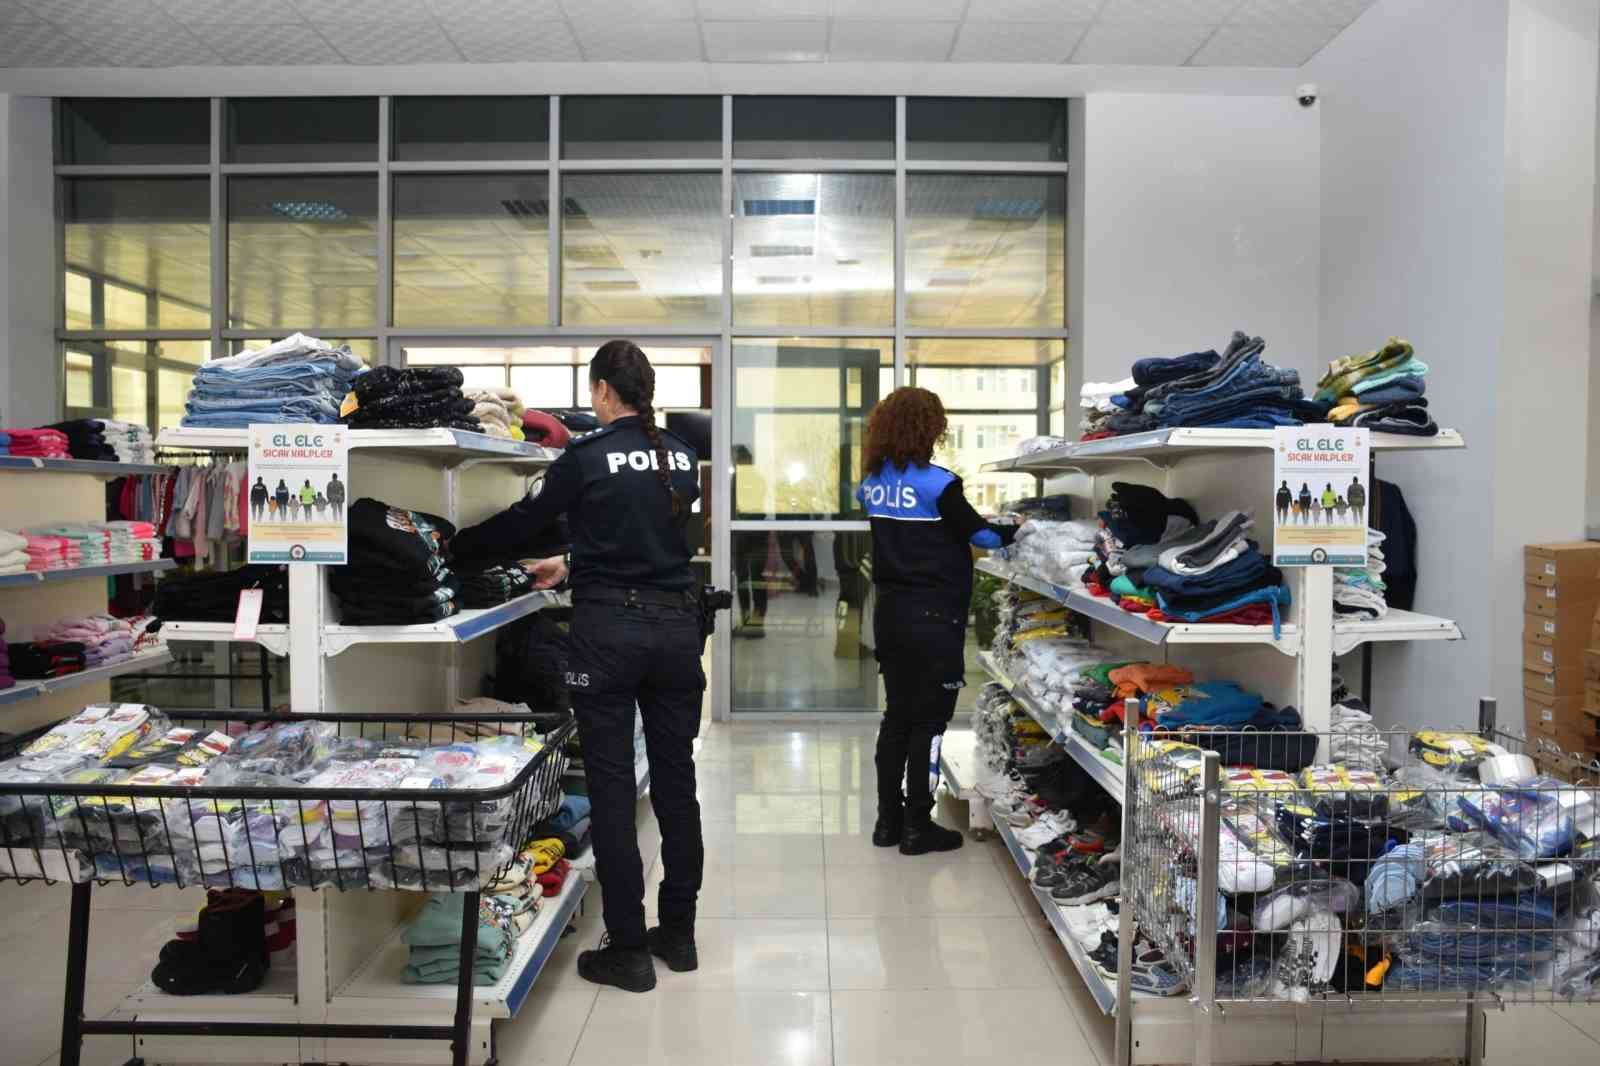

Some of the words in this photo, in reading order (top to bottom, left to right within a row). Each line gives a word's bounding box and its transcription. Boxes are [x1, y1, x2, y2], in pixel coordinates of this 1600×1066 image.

[273, 434, 291, 447] EL
[294, 434, 323, 447] ELE
[1296, 439, 1314, 451] EL
[1317, 439, 1345, 451] ELE
